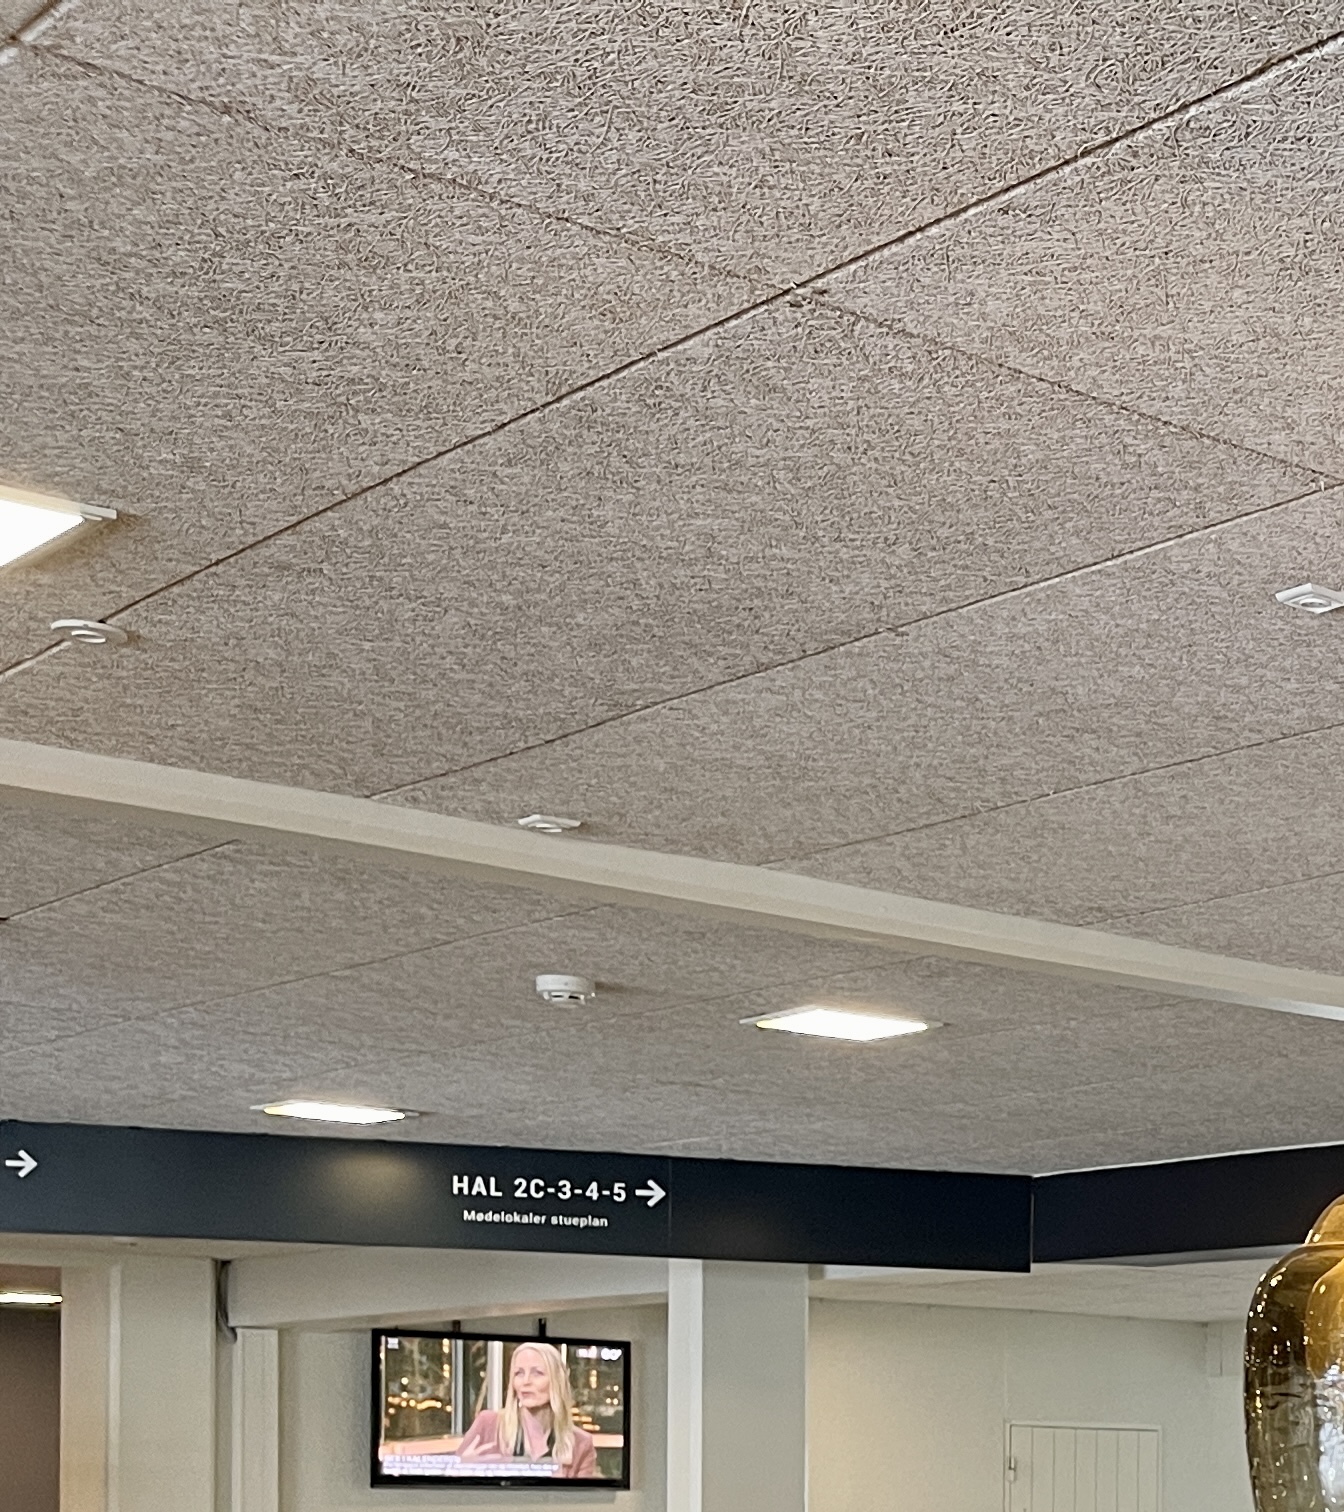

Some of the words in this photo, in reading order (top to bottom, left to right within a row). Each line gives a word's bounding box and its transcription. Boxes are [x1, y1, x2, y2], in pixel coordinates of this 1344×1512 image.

[452, 1175, 503, 1197] HAL
[513, 1177, 627, 1202] 2C-3-4-5
[463, 1209, 547, 1225] Mødelokaler
[550, 1214, 609, 1228] stueplan
